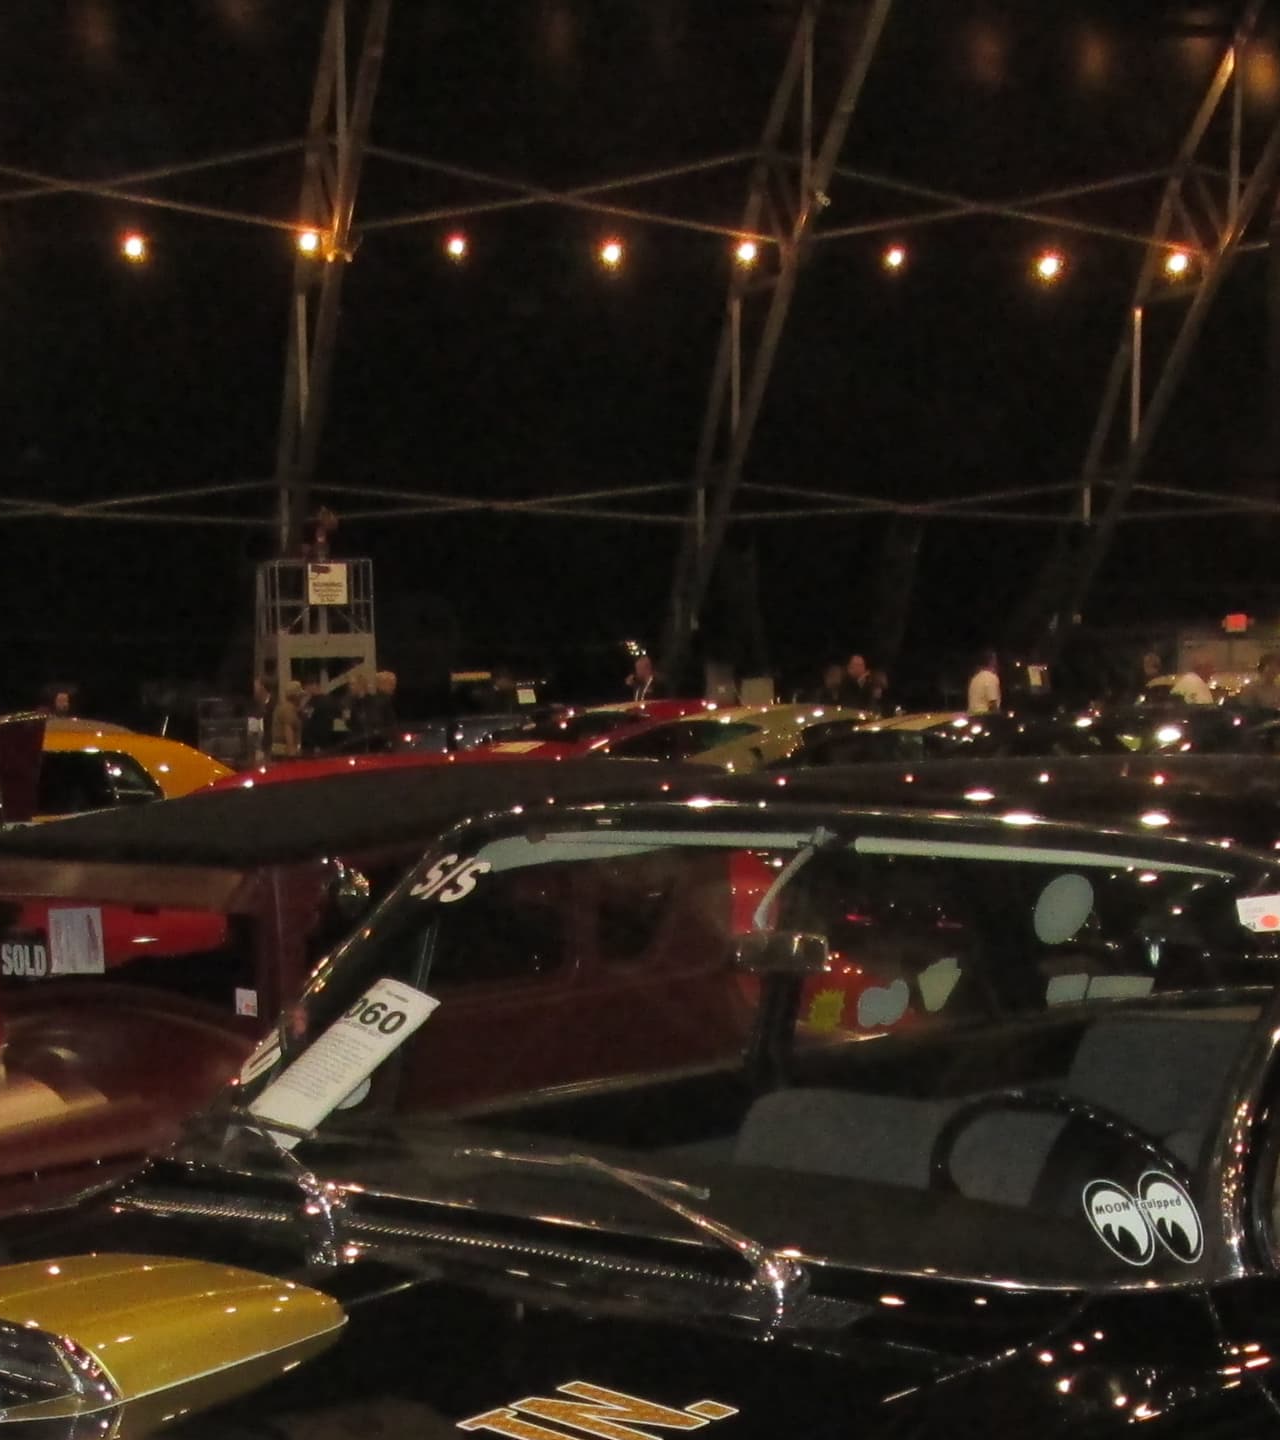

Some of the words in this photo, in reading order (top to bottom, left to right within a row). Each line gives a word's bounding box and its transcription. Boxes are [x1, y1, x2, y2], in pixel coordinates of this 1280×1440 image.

[409, 853, 492, 903] S/S
[1, 943, 47, 977] SOLD
[1094, 1201, 1131, 1215] MOON
[1134, 1195, 1182, 1211] Equipped
